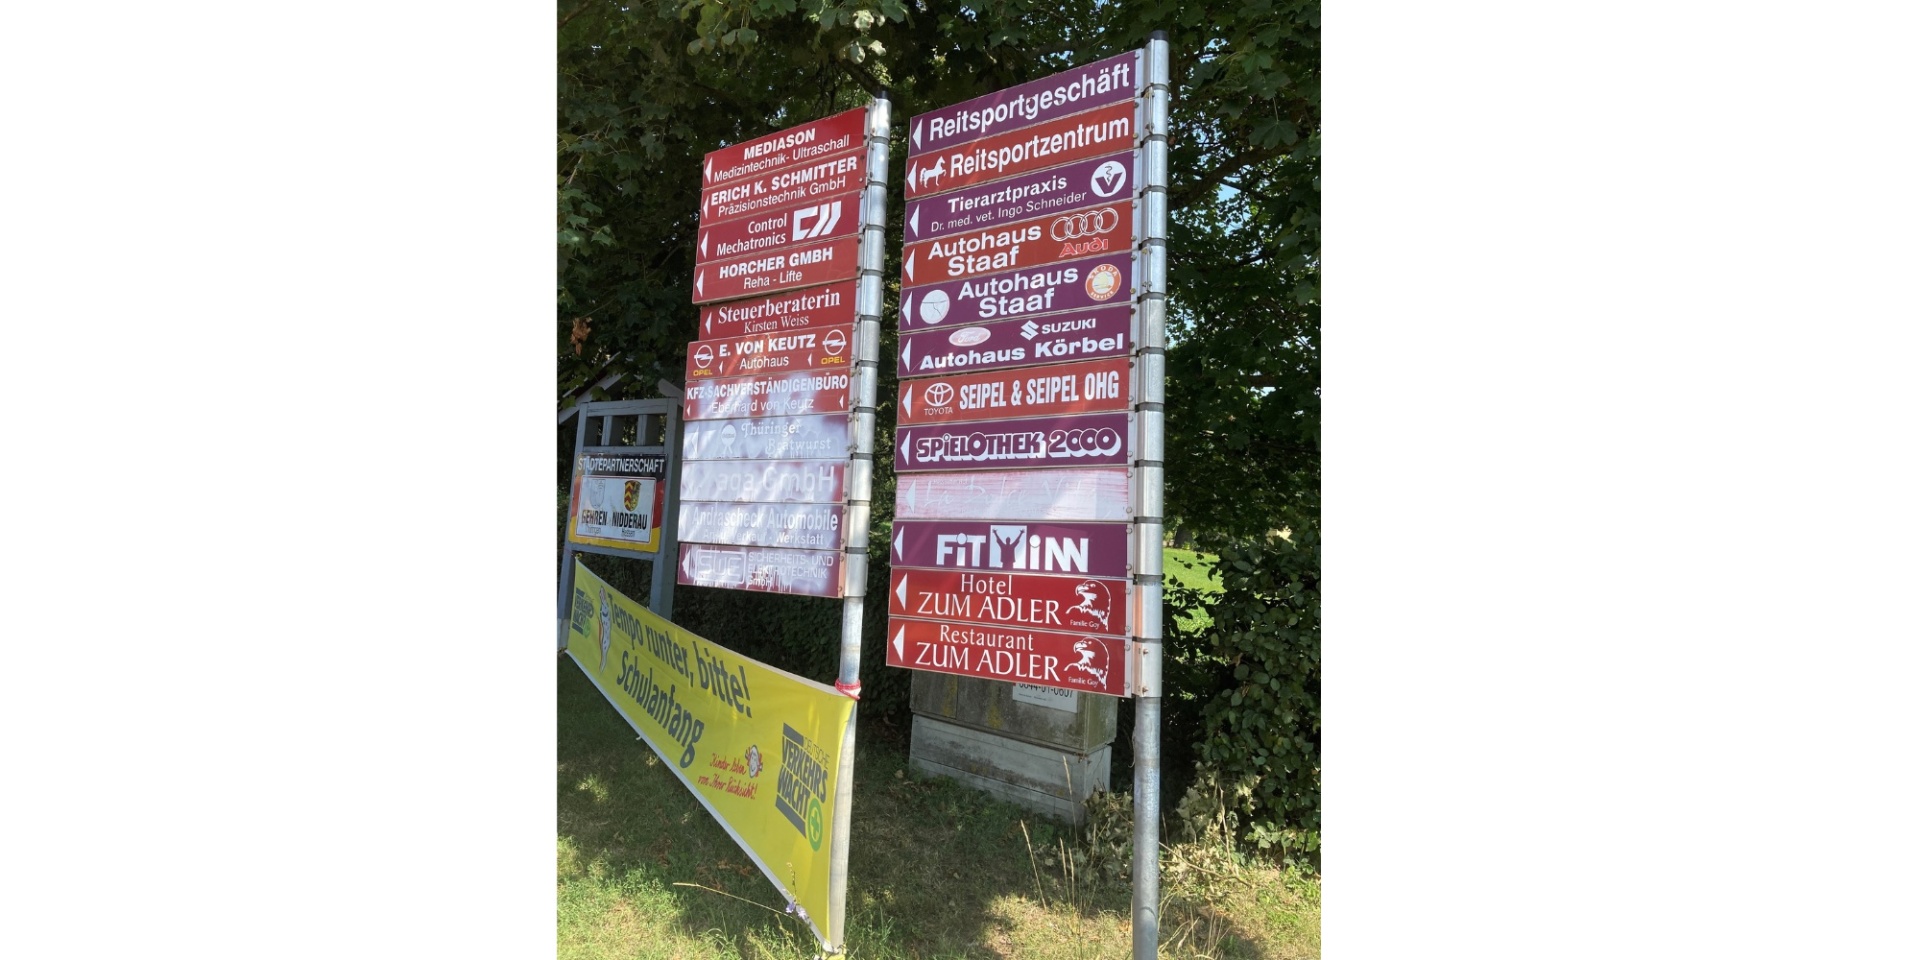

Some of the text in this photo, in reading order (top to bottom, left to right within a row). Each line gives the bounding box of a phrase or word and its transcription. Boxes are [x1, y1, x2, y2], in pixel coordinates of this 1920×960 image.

[929, 63, 1130, 142] Reitsportgeschäft
[714, 134, 850, 182] Medizintechnik- Ultraschall
[743, 128, 816, 160] MEDIASON
[950, 116, 1129, 178] Reitsportzentrum
[711, 156, 857, 206] ERICH K. SCHMITTER
[718, 176, 846, 217] Präzisionstechnik GmbH
[948, 175, 1067, 213] Tierarztpraxis
[748, 213, 787, 234] Control
[931, 191, 1087, 233] Dr. med. vet. Ingo Schneider
[717, 233, 786, 257] Mechatronics
[927, 225, 1042, 260] Autohaus
[719, 247, 833, 279] HORCHER GMBH
[947, 245, 1020, 277] Staaf
[743, 275, 770, 290] Reha
[779, 270, 802, 284] Lifte
[958, 267, 1079, 300] Autohaus
[718, 288, 841, 324] Steuerberaterin
[978, 288, 1054, 318] Staaf
[744, 315, 809, 334] Kirsten Weiss
[1041, 318, 1096, 335] SUZUKI
[719, 333, 816, 357] E. VON KEUTZ
[821, 356, 845, 365] OPEL
[919, 333, 1124, 371] Autohaus Körbel
[693, 369, 713, 377] OPEL
[739, 355, 790, 371] Autohaus
[687, 373, 848, 400] KFZ-SACHVERSTÄNDIGENBÜRO
[959, 371, 1119, 410] SEIPEL & SEIPEL OHG
[711, 397, 814, 414] Eberhard von Keutz
[924, 407, 954, 416] TOYOTA
[741, 421, 801, 439] Thüringer
[1048, 427, 1122, 458] 2000
[578, 457, 665, 473] STÄDTEPARTNERSCHAFT
[611, 511, 648, 530] NIDDERAU
[766, 508, 838, 531] Automobile
[776, 531, 824, 545] Werkstatt
[748, 552, 834, 567] SICHERHEITS- UND
[748, 565, 827, 580] ELEKTROTECHNIK
[961, 574, 1013, 596] Hotel
[917, 591, 1062, 625] ZUM ADLER
[940, 625, 1034, 651] Restaurant
[607, 592, 644, 650] Tempo
[645, 624, 694, 688] runter,
[692, 641, 752, 718] bitte!
[915, 642, 1061, 682] ZUM ADLER
[616, 650, 704, 769] Schulanfang
[804, 737, 830, 770] DEUTSCHE
[782, 735, 828, 804] VERKEHRS
[778, 764, 811, 820] WACHT
